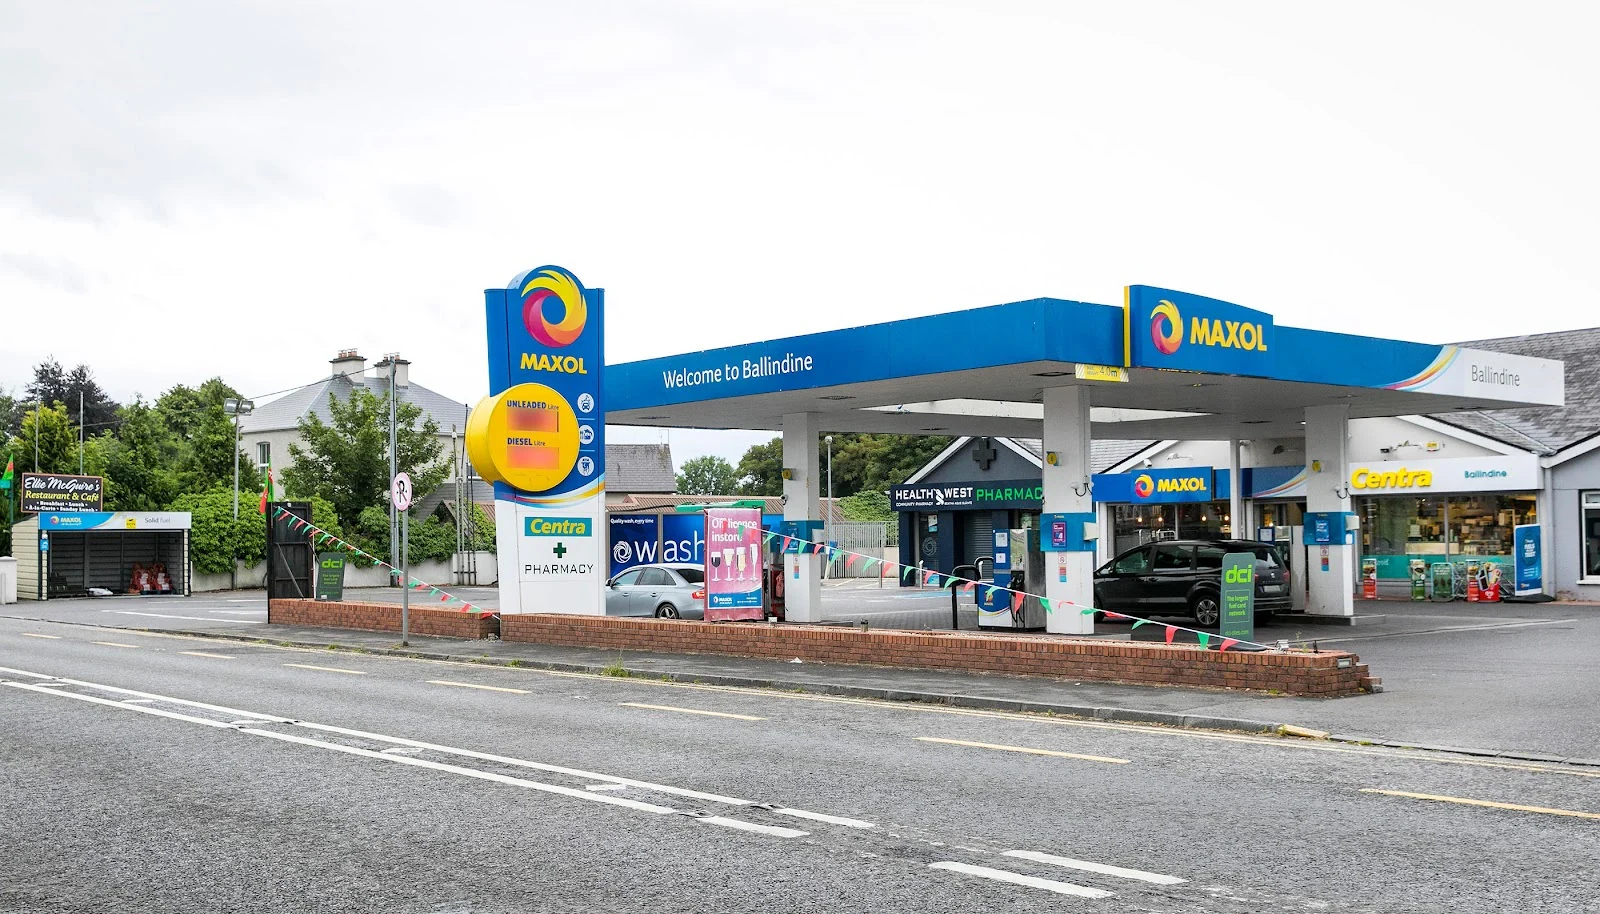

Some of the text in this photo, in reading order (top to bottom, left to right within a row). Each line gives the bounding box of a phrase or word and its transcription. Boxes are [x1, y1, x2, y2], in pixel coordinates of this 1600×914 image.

[1190, 317, 1267, 351] MAXOL
[520, 353, 587, 374] MAXOL
[663, 353, 813, 389] Welcome to Ballindine
[1471, 364, 1520, 387] Ballindine
[506, 400, 546, 409] UNLEADED
[507, 437, 533, 446] DIESEL
[24, 477, 100, 493] Ellie McGuire's
[1157, 477, 1207, 493] MAXOL
[1351, 467, 1507, 489] Centra Ballindine
[25, 490, 70, 500] Restaurant
[81, 492, 99, 502] Café
[895, 487, 973, 500] HEALTH WEST
[976, 487, 1042, 501] PHARMAC
[530, 517, 586, 535] Centra
[634, 530, 704, 562] wash
[322, 559, 343, 569] dci
[525, 564, 594, 575] PHARMACY
[1225, 564, 1252, 584] dci
[1234, 595, 1248, 603] largest
